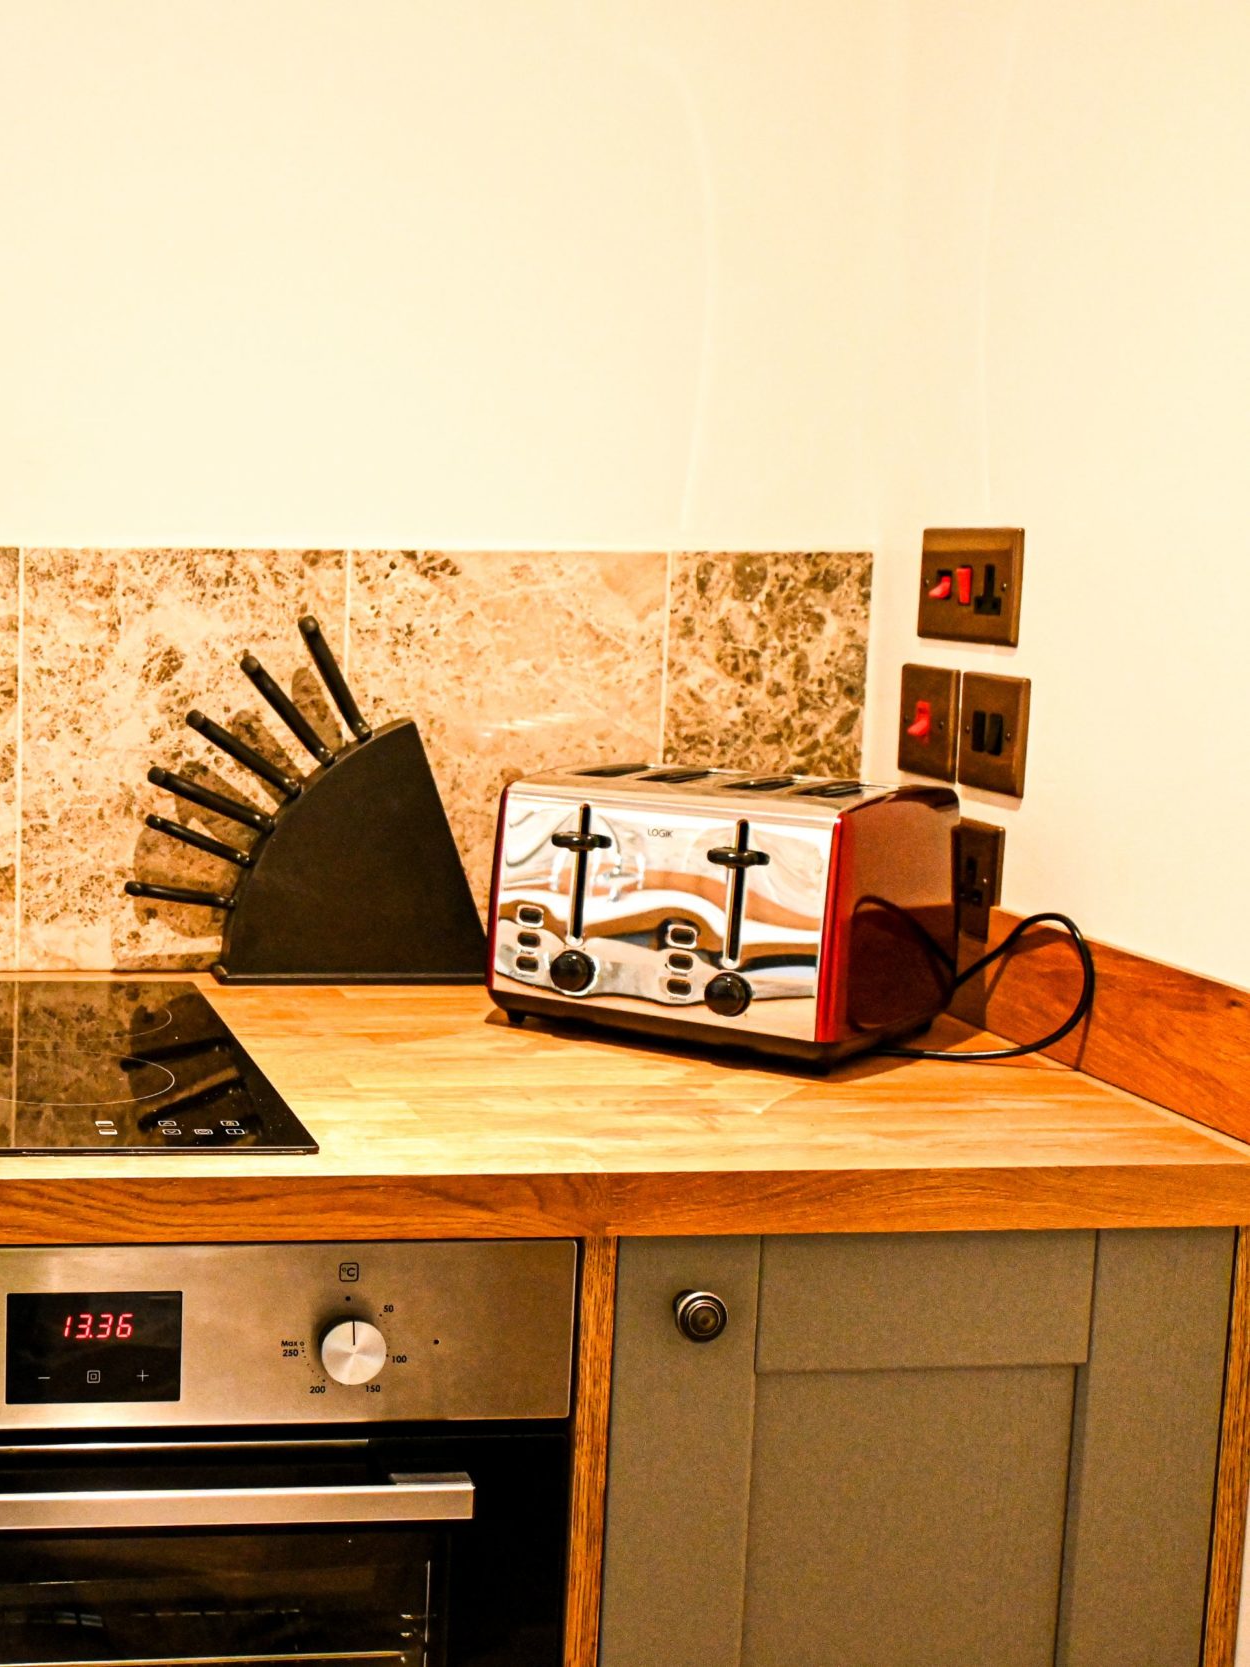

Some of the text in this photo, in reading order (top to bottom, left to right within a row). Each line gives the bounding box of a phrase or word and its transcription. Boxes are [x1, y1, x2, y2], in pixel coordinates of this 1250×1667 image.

[647, 828, 674, 838] LOGIK
[383, 1304, 394, 1313] 50
[62, 1312, 134, 1340] 13.36
[282, 1349, 299, 1357] 250
[392, 1355, 407, 1363] 100
[309, 1385, 326, 1394] 200
[365, 1384, 381, 1393] 150
